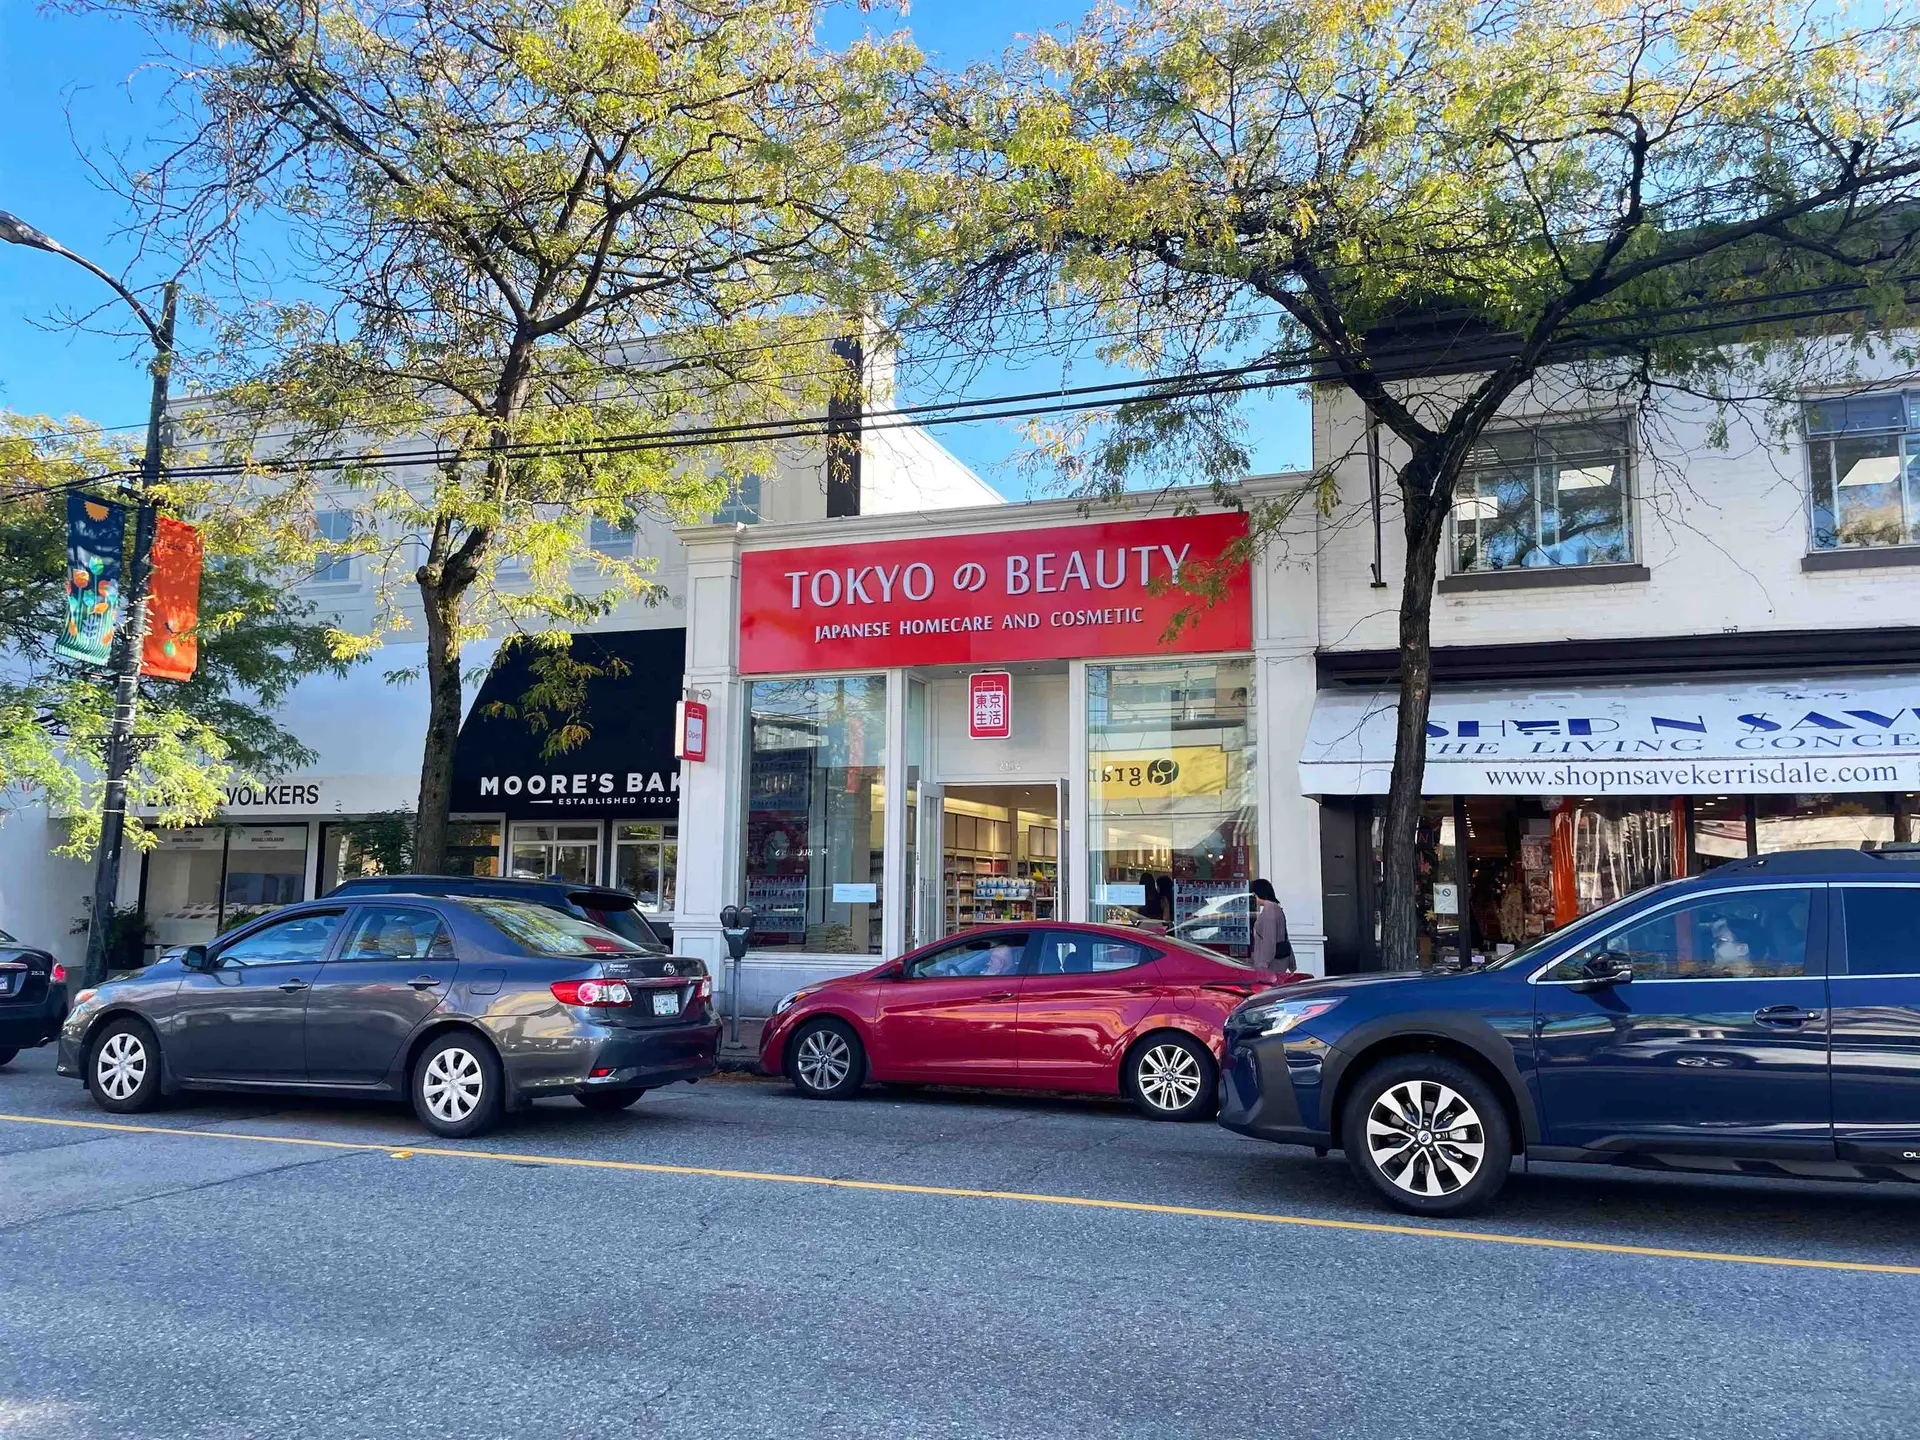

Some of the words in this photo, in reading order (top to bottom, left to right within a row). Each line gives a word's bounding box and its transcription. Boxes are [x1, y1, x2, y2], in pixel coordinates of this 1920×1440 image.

[784, 562, 936, 609] TOKYO
[953, 562, 988, 592] の
[1006, 543, 1190, 596] BEAUTY
[815, 621, 891, 644] JAPANESE
[899, 615, 994, 636] HOMECARE
[1001, 612, 1041, 630] AND
[1050, 607, 1144, 627] COSMETIC
[975, 693, 1002, 709] 東京
[975, 710, 1002, 726] 生活
[1650, 715, 1708, 735] N
[1529, 738, 1706, 755] LIVING
[1735, 733, 1920, 751] CONCE
[480, 773, 615, 796] MOORE'S
[1485, 761, 1899, 792] www.shopnsavekerrisdale.com
[227, 781, 319, 806] VÖLKERS
[558, 797, 637, 805] ESTABLISHED
[643, 796, 672, 804] 1930
